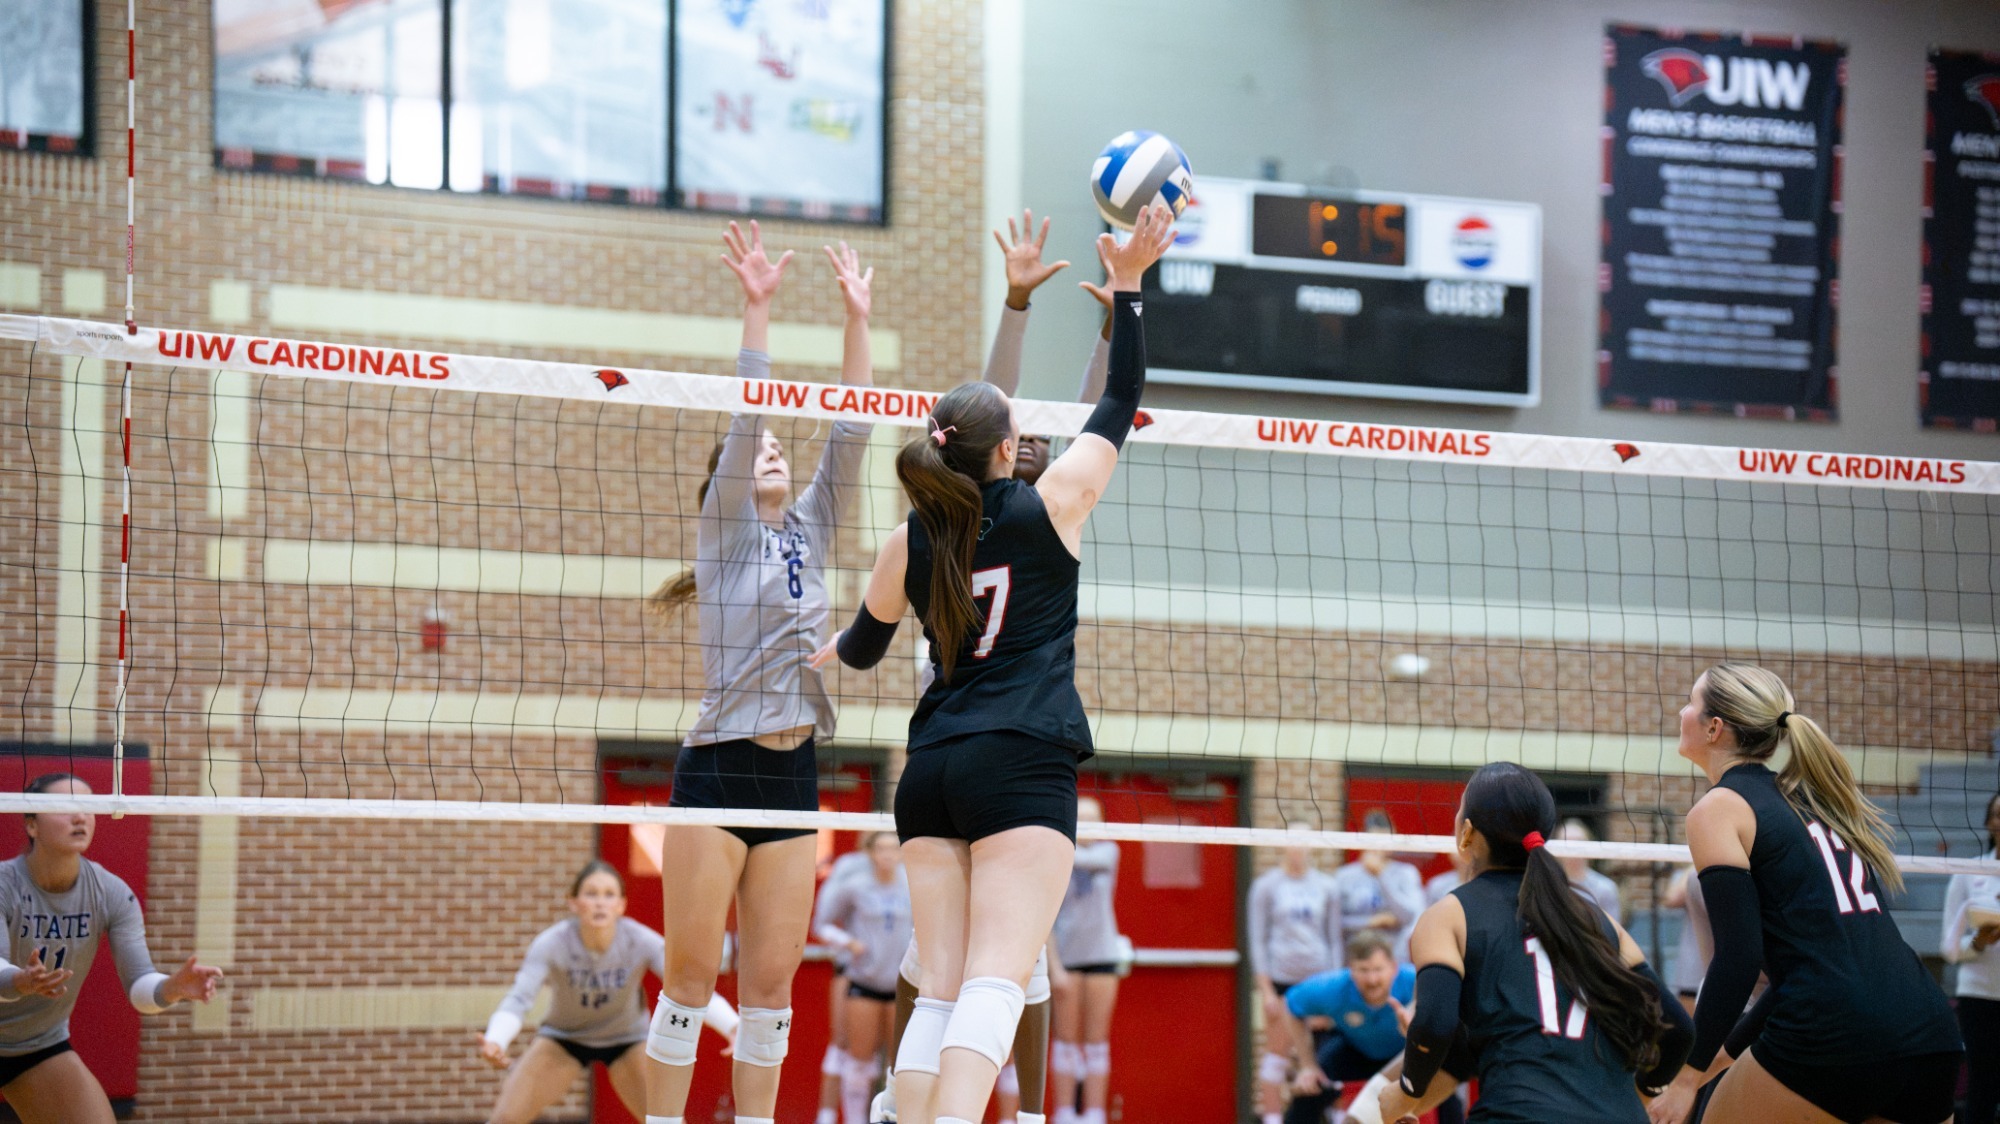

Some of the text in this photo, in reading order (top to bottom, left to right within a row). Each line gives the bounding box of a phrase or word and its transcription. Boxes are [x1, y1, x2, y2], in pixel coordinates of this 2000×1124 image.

[1703, 54, 1811, 110] UIW
[1698, 112, 1817, 147] BASKETBALL
[1159, 258, 1215, 296] UIW
[1425, 280, 1506, 317] GUEST
[76, 331, 97, 339] sports
[158, 330, 450, 380] UIW CARDINALS
[743, 381, 938, 418] UIW CARDIN
[1257, 419, 1491, 456] UIW CARDINALS
[1739, 450, 1966, 484] UIW CARDINALS
[787, 558, 804, 599] 6
[971, 563, 1012, 659] 7
[20, 913, 91, 939] STATE
[566, 968, 629, 989] STATE
